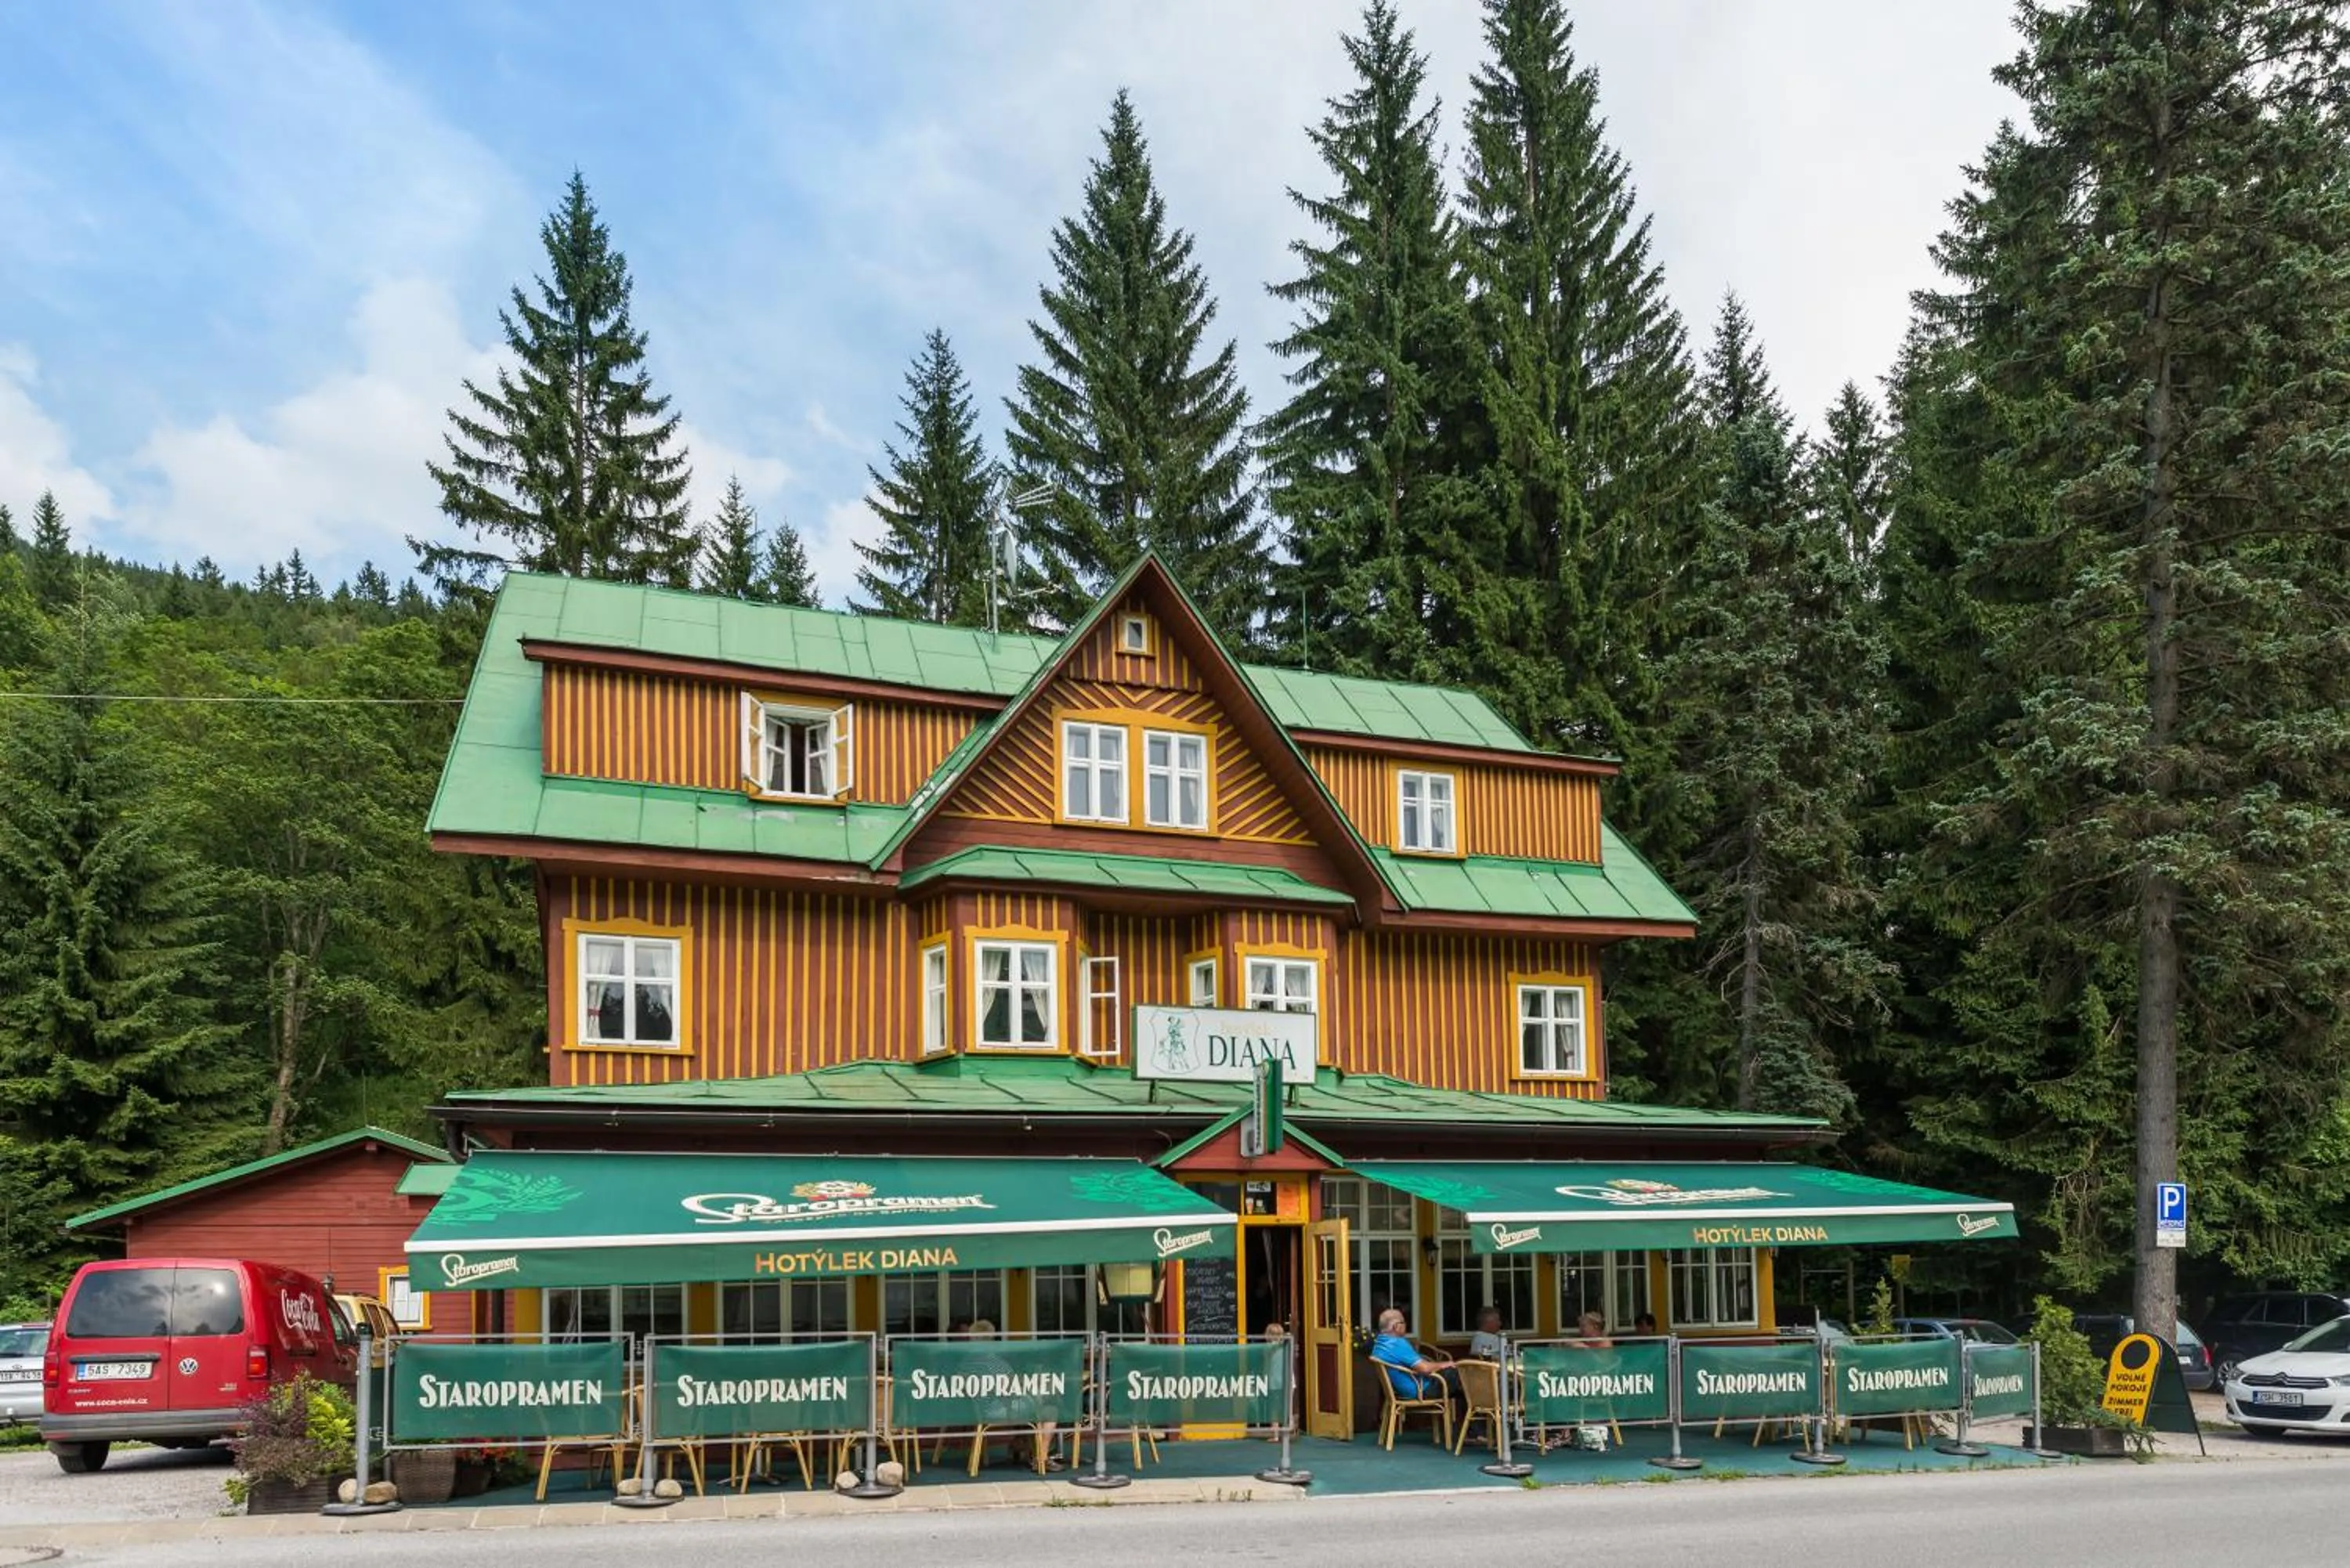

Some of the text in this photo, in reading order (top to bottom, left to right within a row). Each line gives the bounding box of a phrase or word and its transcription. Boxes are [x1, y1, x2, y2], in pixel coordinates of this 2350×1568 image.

[1209, 1035, 1296, 1070] DIANA
[681, 1193, 997, 1223] Staropramen
[2164, 1187, 2180, 1218] P
[1694, 1225, 1828, 1244] HOTÝLEK DIANA
[441, 1253, 519, 1287] Staropramen
[754, 1248, 958, 1274] HOTÝLEK DIANA
[88, 1363, 146, 1376] 5AS 7349
[912, 1368, 1065, 1400] STAROPRAMEN
[1538, 1371, 1654, 1397] STAROPRAMEN
[1697, 1369, 1806, 1395] STAROPRAMEN
[1848, 1367, 1948, 1392] STAROPRAMEN
[419, 1375, 602, 1408] STAROPRAMEN
[677, 1375, 848, 1407] STAROPRAMEN
[1127, 1370, 1268, 1400] STAROPRAMEN
